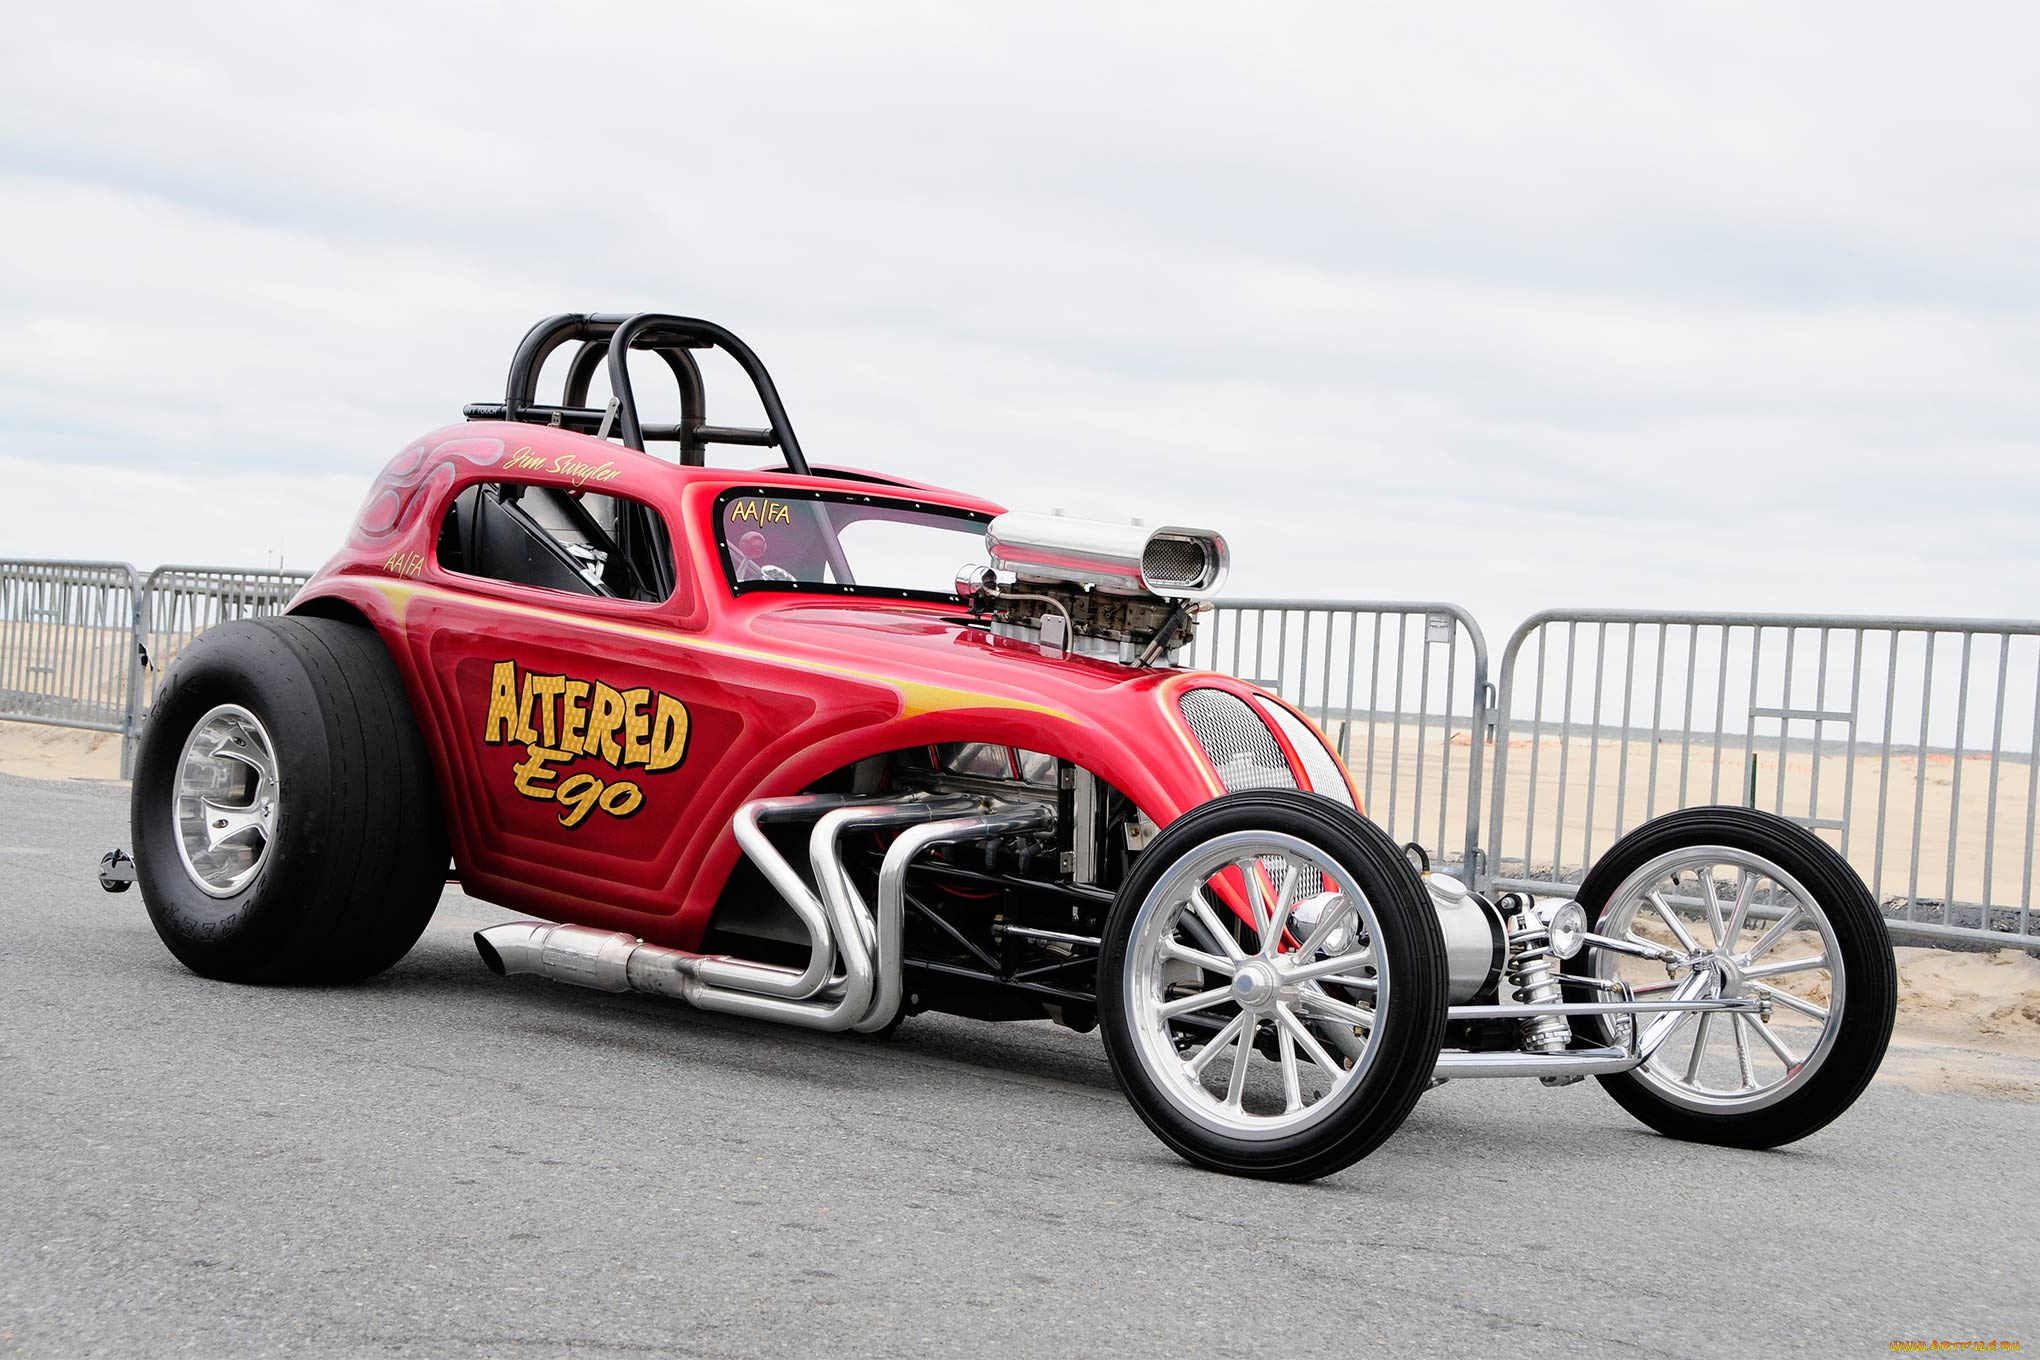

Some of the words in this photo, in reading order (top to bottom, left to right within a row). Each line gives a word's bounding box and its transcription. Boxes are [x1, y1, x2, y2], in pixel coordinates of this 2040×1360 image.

[502, 446, 546, 470] Jim
[544, 454, 623, 487] Swagler
[484, 658, 692, 775] ALTERED
[512, 741, 647, 830] Ego
